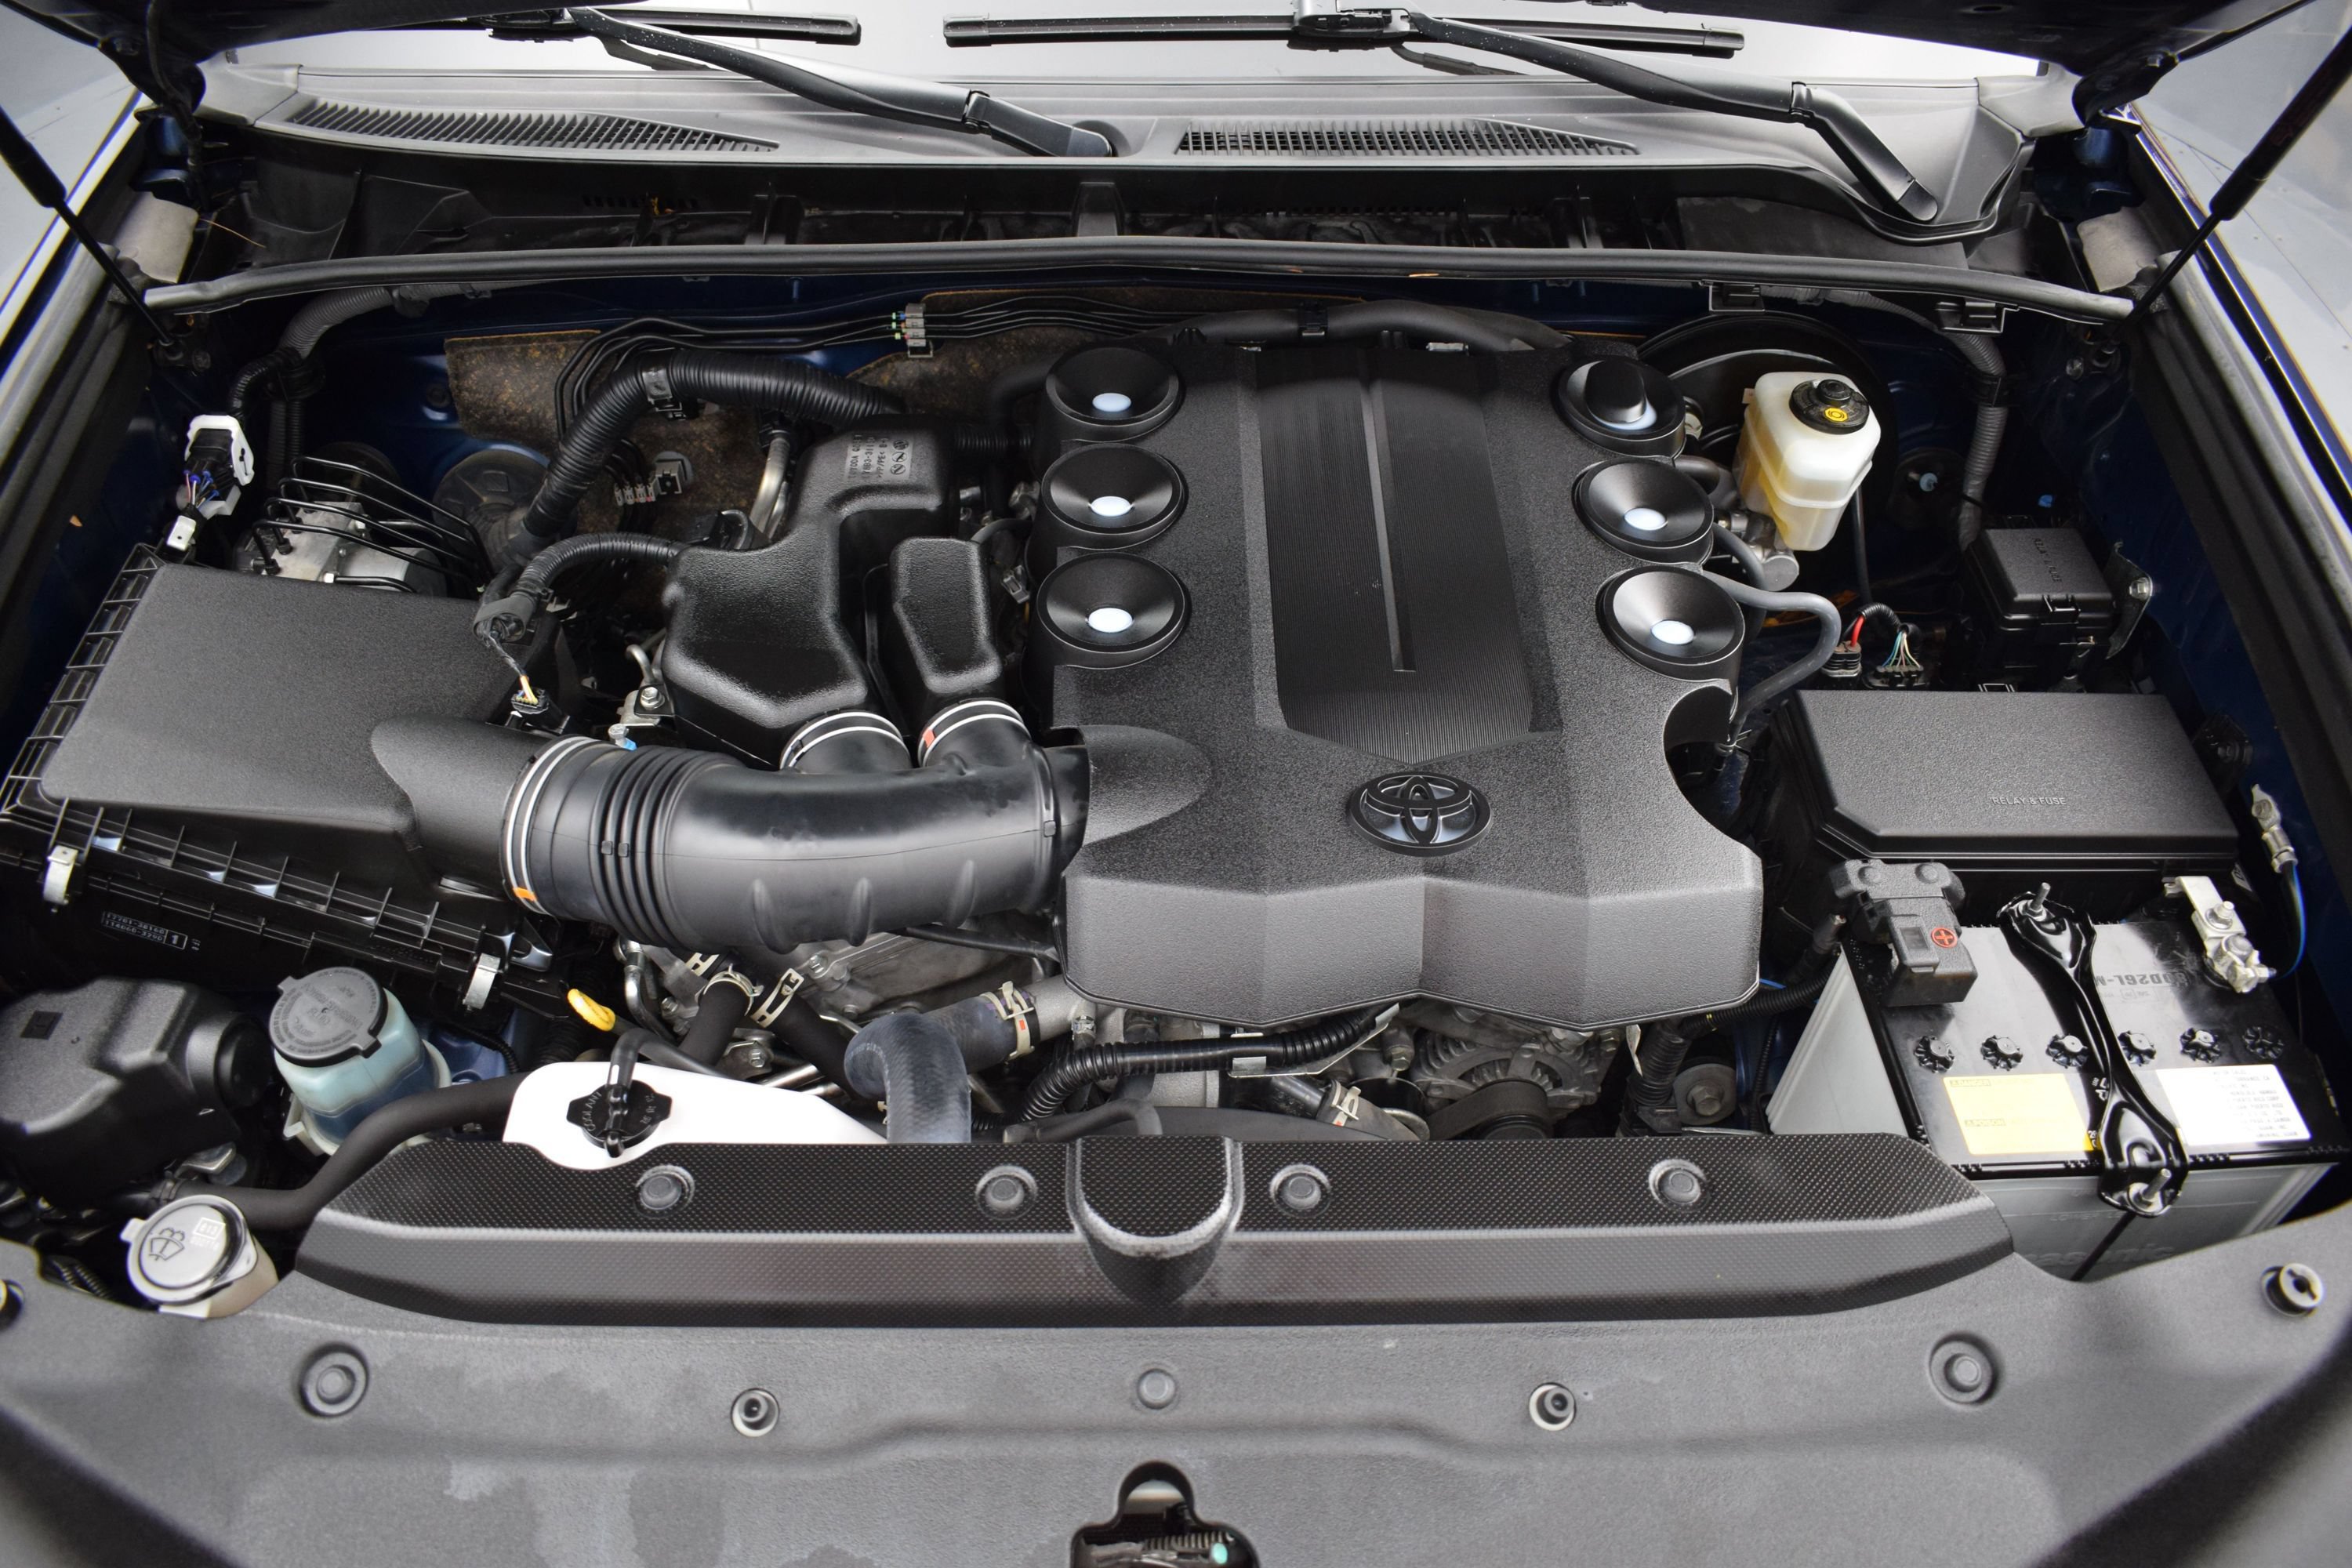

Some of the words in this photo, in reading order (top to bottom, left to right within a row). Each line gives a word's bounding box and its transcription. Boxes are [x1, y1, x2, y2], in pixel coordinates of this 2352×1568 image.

[1991, 797, 2026, 806] RELAY
[2038, 797, 2067, 806] FUSE
[580, 1090, 604, 1132] COOLANT
